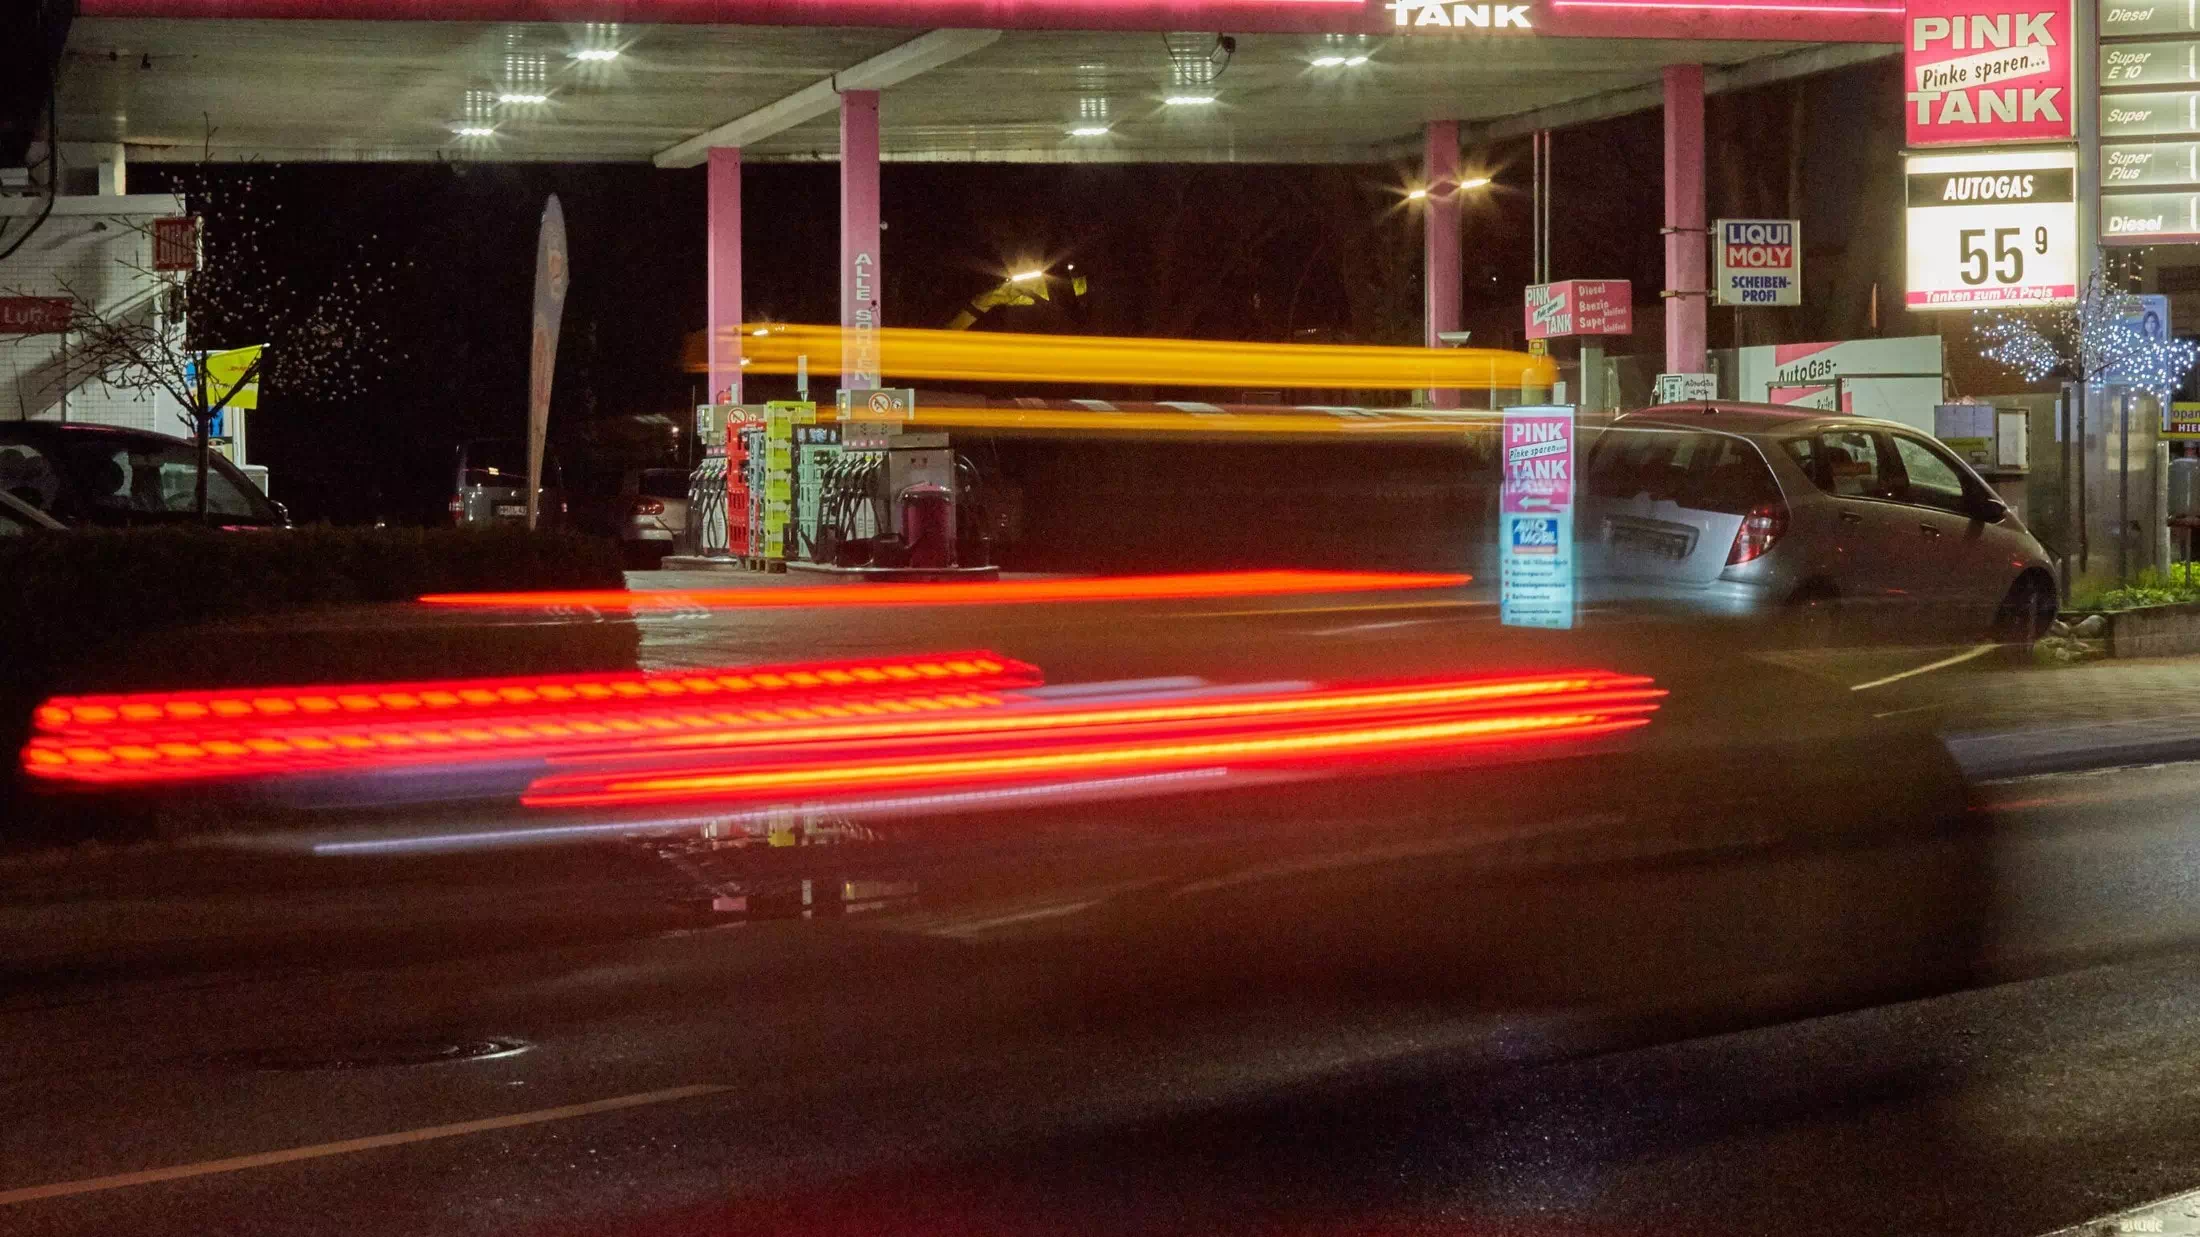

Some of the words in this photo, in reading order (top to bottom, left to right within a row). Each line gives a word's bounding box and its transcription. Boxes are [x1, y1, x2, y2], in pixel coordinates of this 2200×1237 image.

[1385, 3, 1532, 28] TANK
[2107, 8, 2154, 22] Diesel
[1913, 12, 2056, 51] PINK
[2107, 51, 2151, 66] Super
[1923, 64, 1967, 90] Pinke
[2108, 66, 2121, 79] E
[2125, 65, 2142, 79] 10
[1907, 87, 2064, 125] TANK
[2108, 109, 2152, 124] Super
[2108, 151, 2152, 166] Super
[2108, 166, 2141, 180] Plus
[1943, 174, 2034, 201] AUTOGAS
[2108, 215, 2163, 232] Diesel
[1729, 224, 1789, 245] LIQUI
[1729, 246, 1791, 267] MOLY
[1959, 227, 2024, 286] 55
[855, 253, 873, 301] ALLE
[1731, 275, 1792, 289] SCHEIBEN-
[1525, 286, 1551, 308] PINK
[1579, 283, 1606, 297] Diesel
[1742, 289, 1777, 302] PROFI
[1925, 290, 1970, 303] Tanken
[1974, 291, 2000, 301] zum
[2020, 286, 2053, 299] Preis
[1545, 313, 1572, 335] TANK
[1579, 317, 1606, 329] Super
[1777, 358, 1838, 383] AutoGas-
[1512, 422, 1564, 443] PINK
[1510, 448, 1529, 460] Pinke
[1509, 459, 1568, 480] TANK
